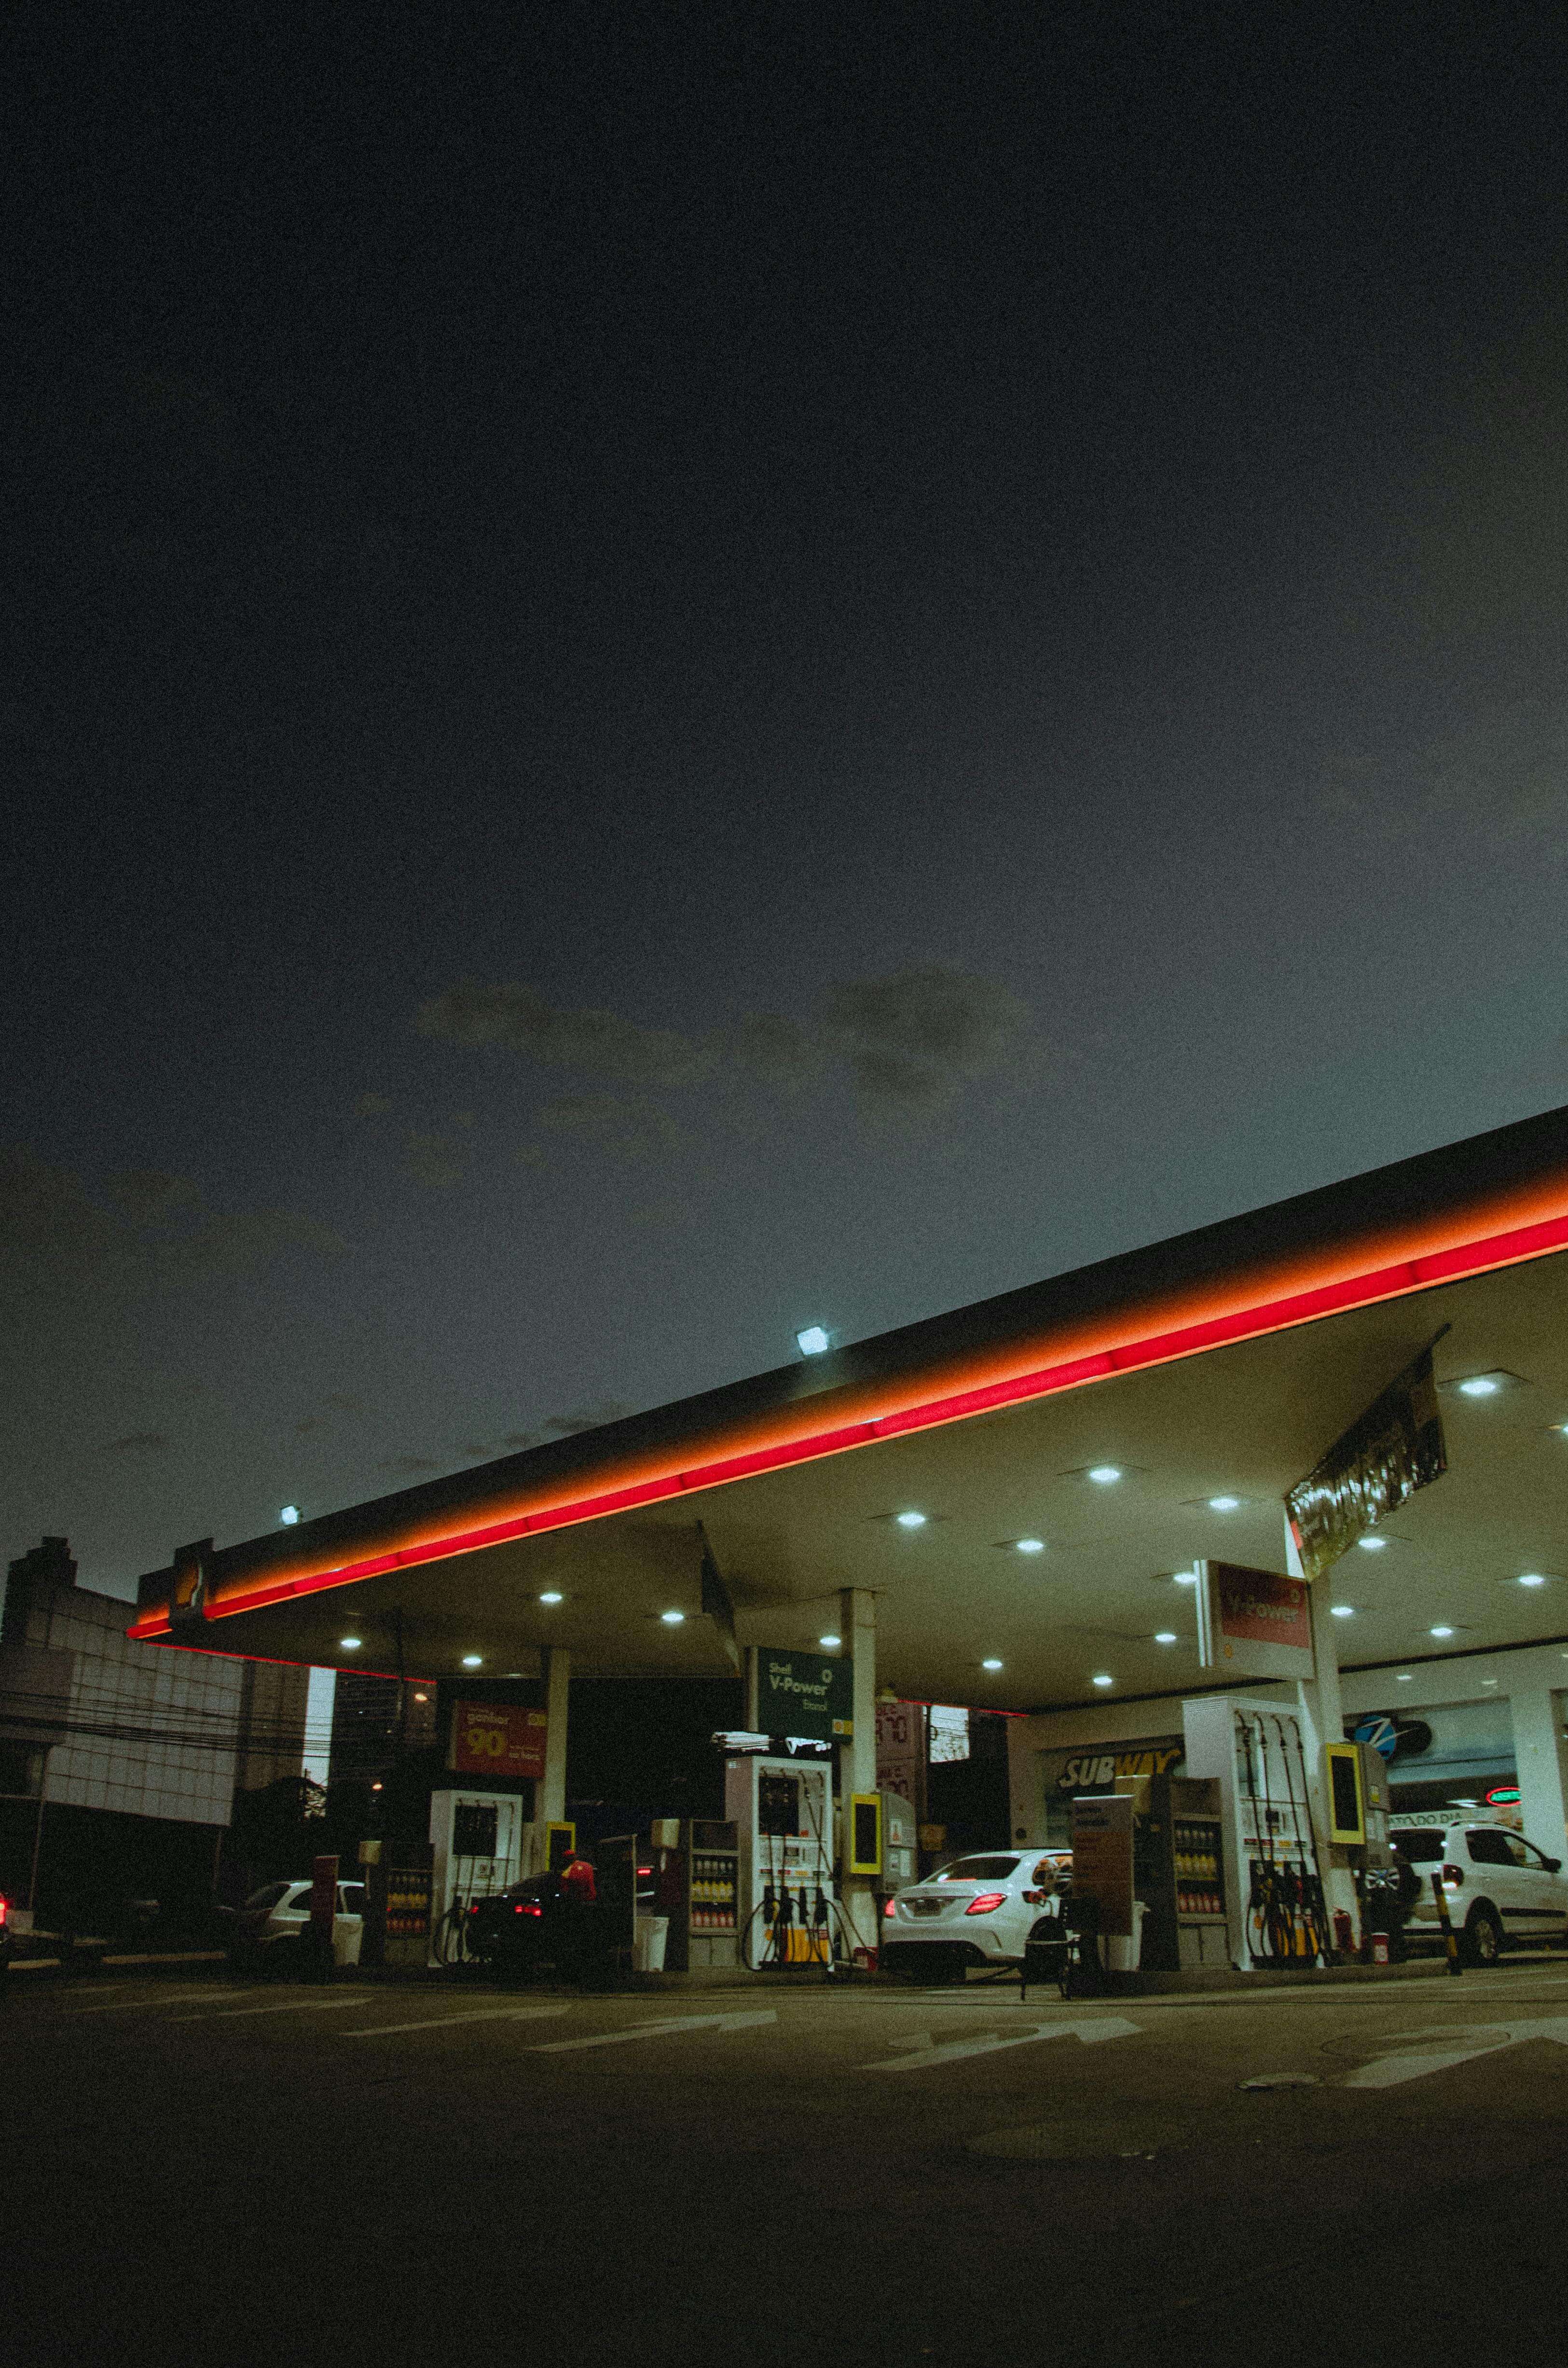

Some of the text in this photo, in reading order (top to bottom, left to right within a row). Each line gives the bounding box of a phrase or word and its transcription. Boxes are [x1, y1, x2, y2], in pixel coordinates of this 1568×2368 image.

[769, 1675, 828, 1696] V-Power
[467, 1728, 508, 1756] 90
[1058, 1748, 1182, 1788] SUBWAY
